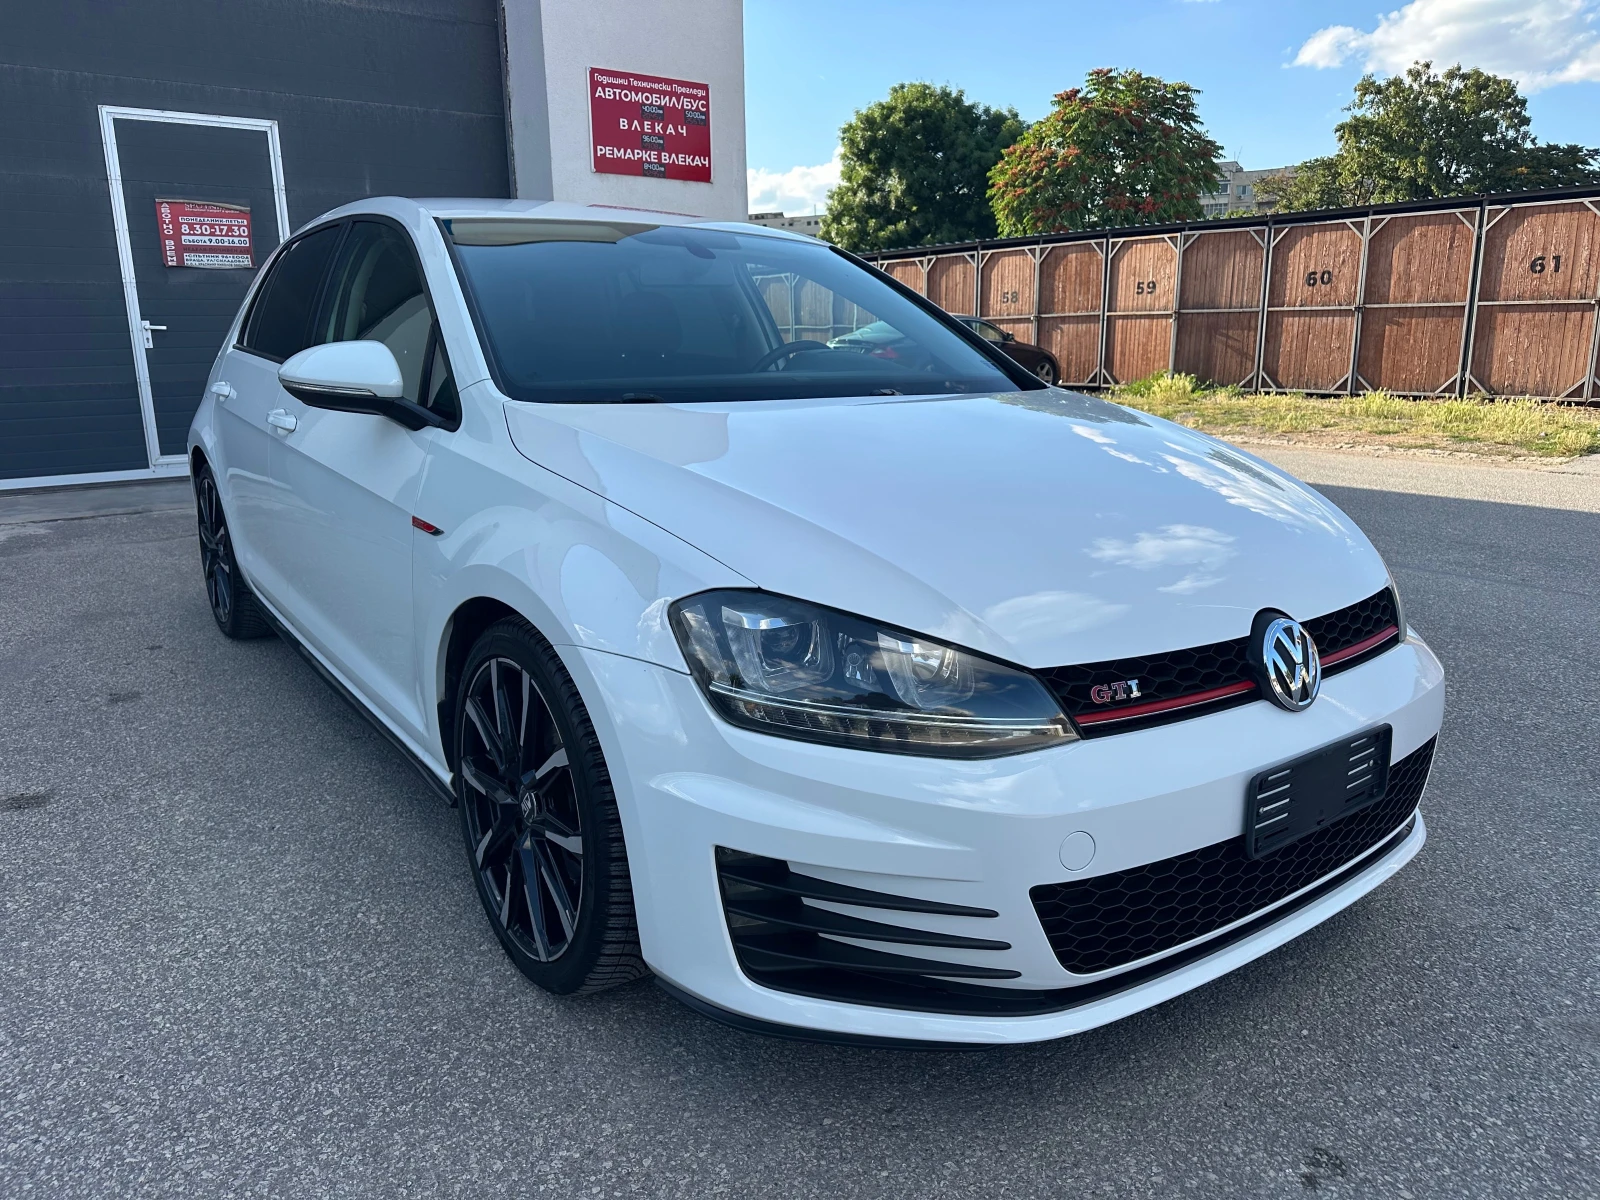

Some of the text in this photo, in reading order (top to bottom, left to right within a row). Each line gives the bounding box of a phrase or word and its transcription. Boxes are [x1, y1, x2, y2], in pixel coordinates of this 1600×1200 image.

[594, 73, 706, 97] Годишни Технически Прегледи
[595, 86, 707, 111] АВТОМОБИЛ/БУС
[596, 145, 658, 163] РЕМАРКЕ
[661, 152, 709, 168] ВЛЕКАЧ
[181, 224, 248, 236] 8.30-17.30
[207, 237, 248, 246] 9.00-16.00
[1530, 255, 1562, 274] 61
[1305, 270, 1333, 287] 60
[1136, 281, 1157, 295] 59
[1002, 291, 1019, 304] 58
[1091, 679, 1141, 704] GTI
